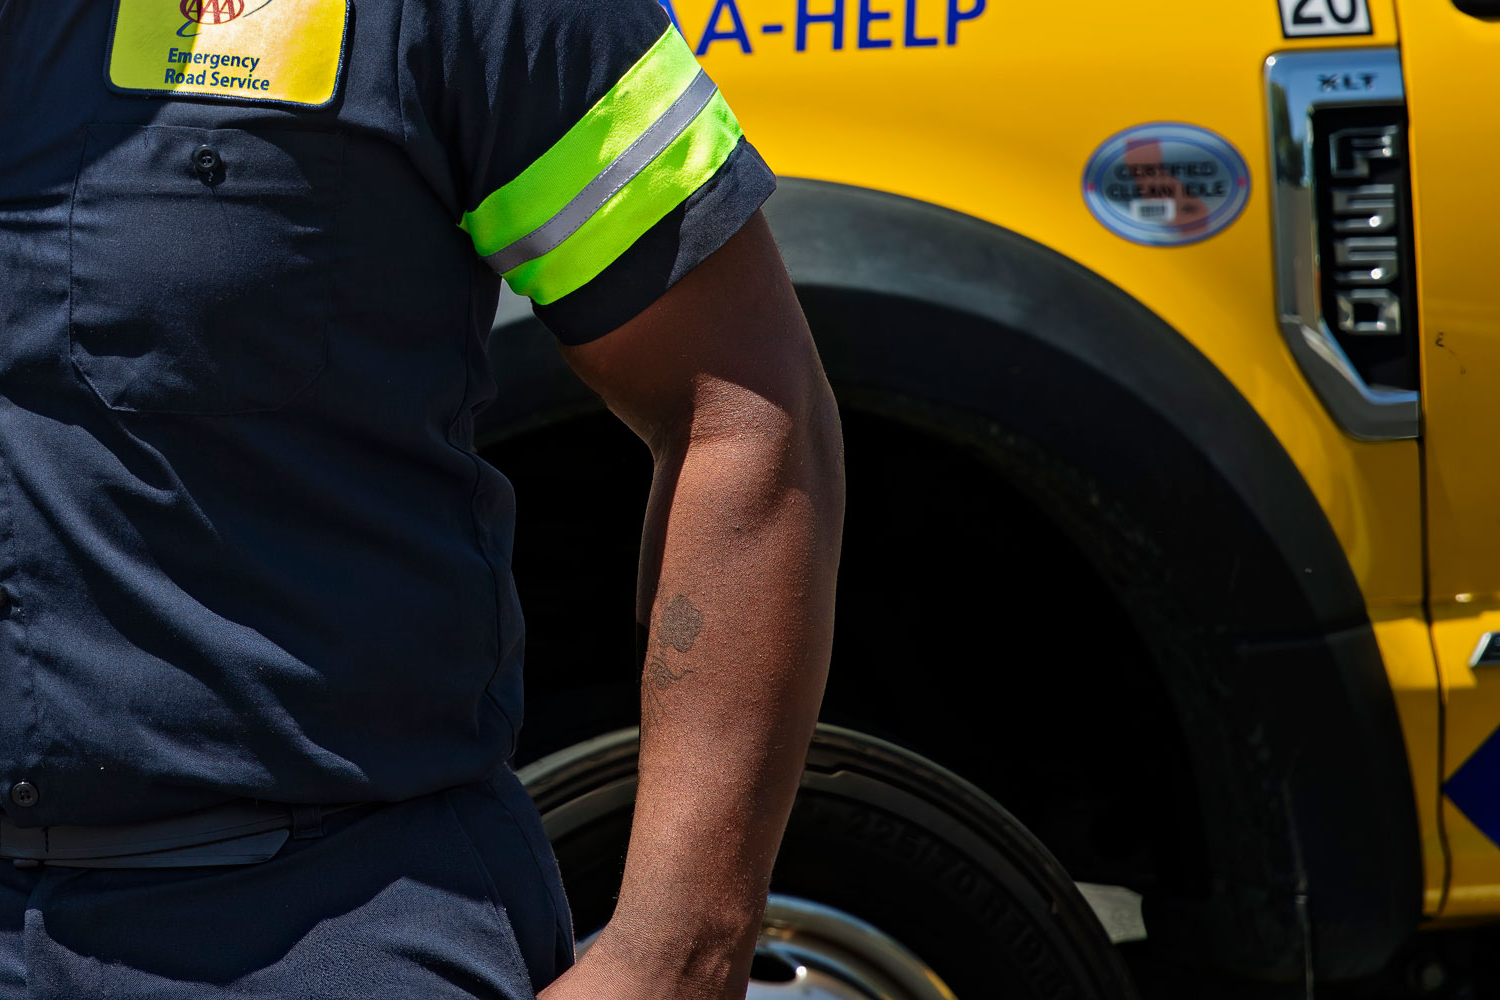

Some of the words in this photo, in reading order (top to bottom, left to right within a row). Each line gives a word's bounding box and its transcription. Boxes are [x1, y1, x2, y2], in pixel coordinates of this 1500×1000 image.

[168, 48, 260, 71] Emergency
[164, 68, 206, 85] Road
[210, 71, 270, 90] Service
[1317, 72, 1378, 91] XLT
